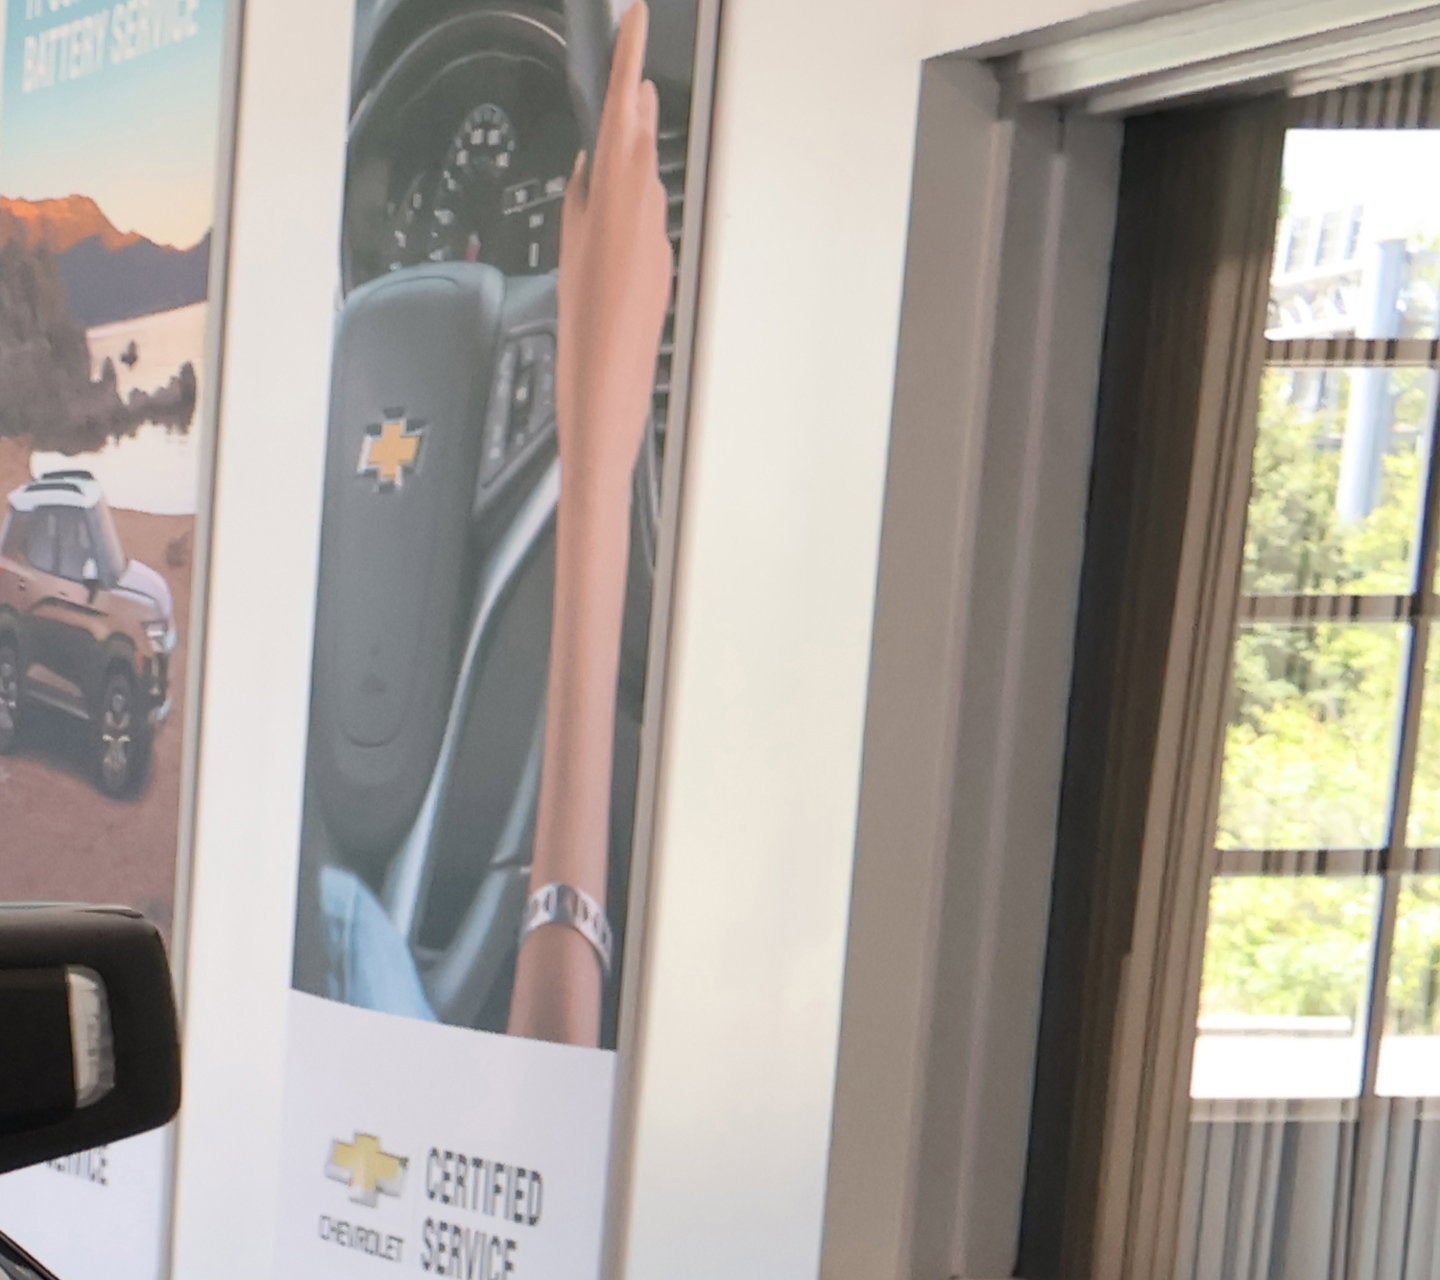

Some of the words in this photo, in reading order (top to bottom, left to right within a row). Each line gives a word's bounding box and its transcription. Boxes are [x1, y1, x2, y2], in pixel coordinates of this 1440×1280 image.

[21, 8, 110, 93] BATTERY
[425, 1146, 544, 1227] CERTIFIED
[318, 1213, 404, 1263] CHEVROLET
